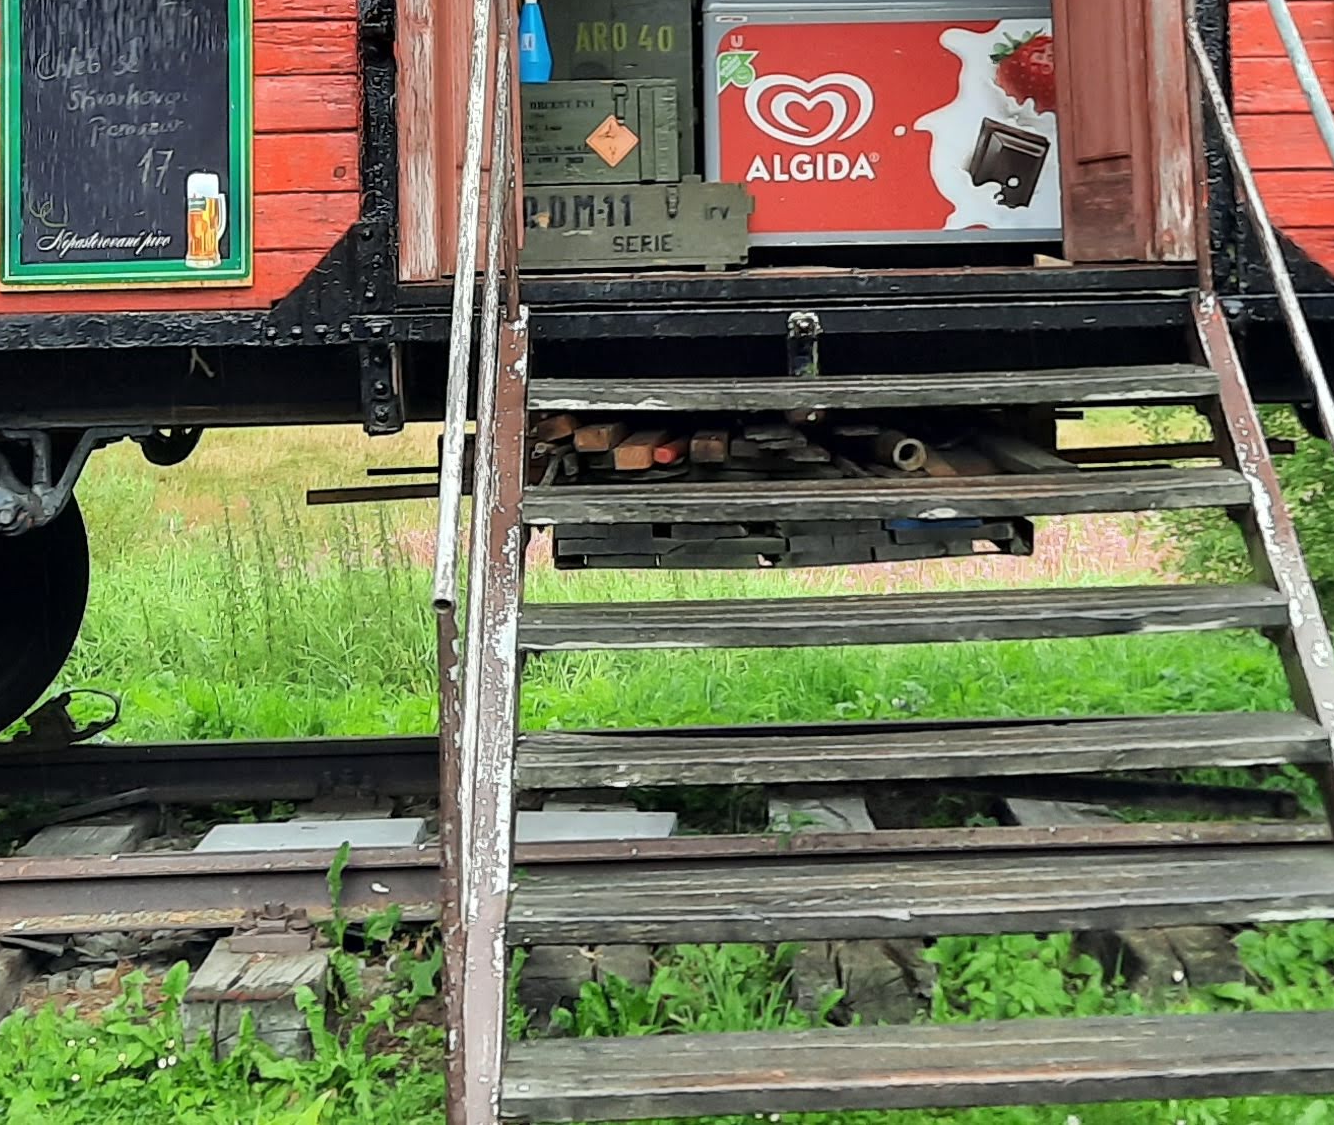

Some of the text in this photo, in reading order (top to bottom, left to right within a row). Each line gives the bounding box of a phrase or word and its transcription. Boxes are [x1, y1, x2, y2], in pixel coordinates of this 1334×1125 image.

[575, 23, 675, 54] ARO 40
[745, 153, 875, 182] ALGIDA
[134, 231, 172, 256] pivo
[612, 234, 674, 253] SERIE
